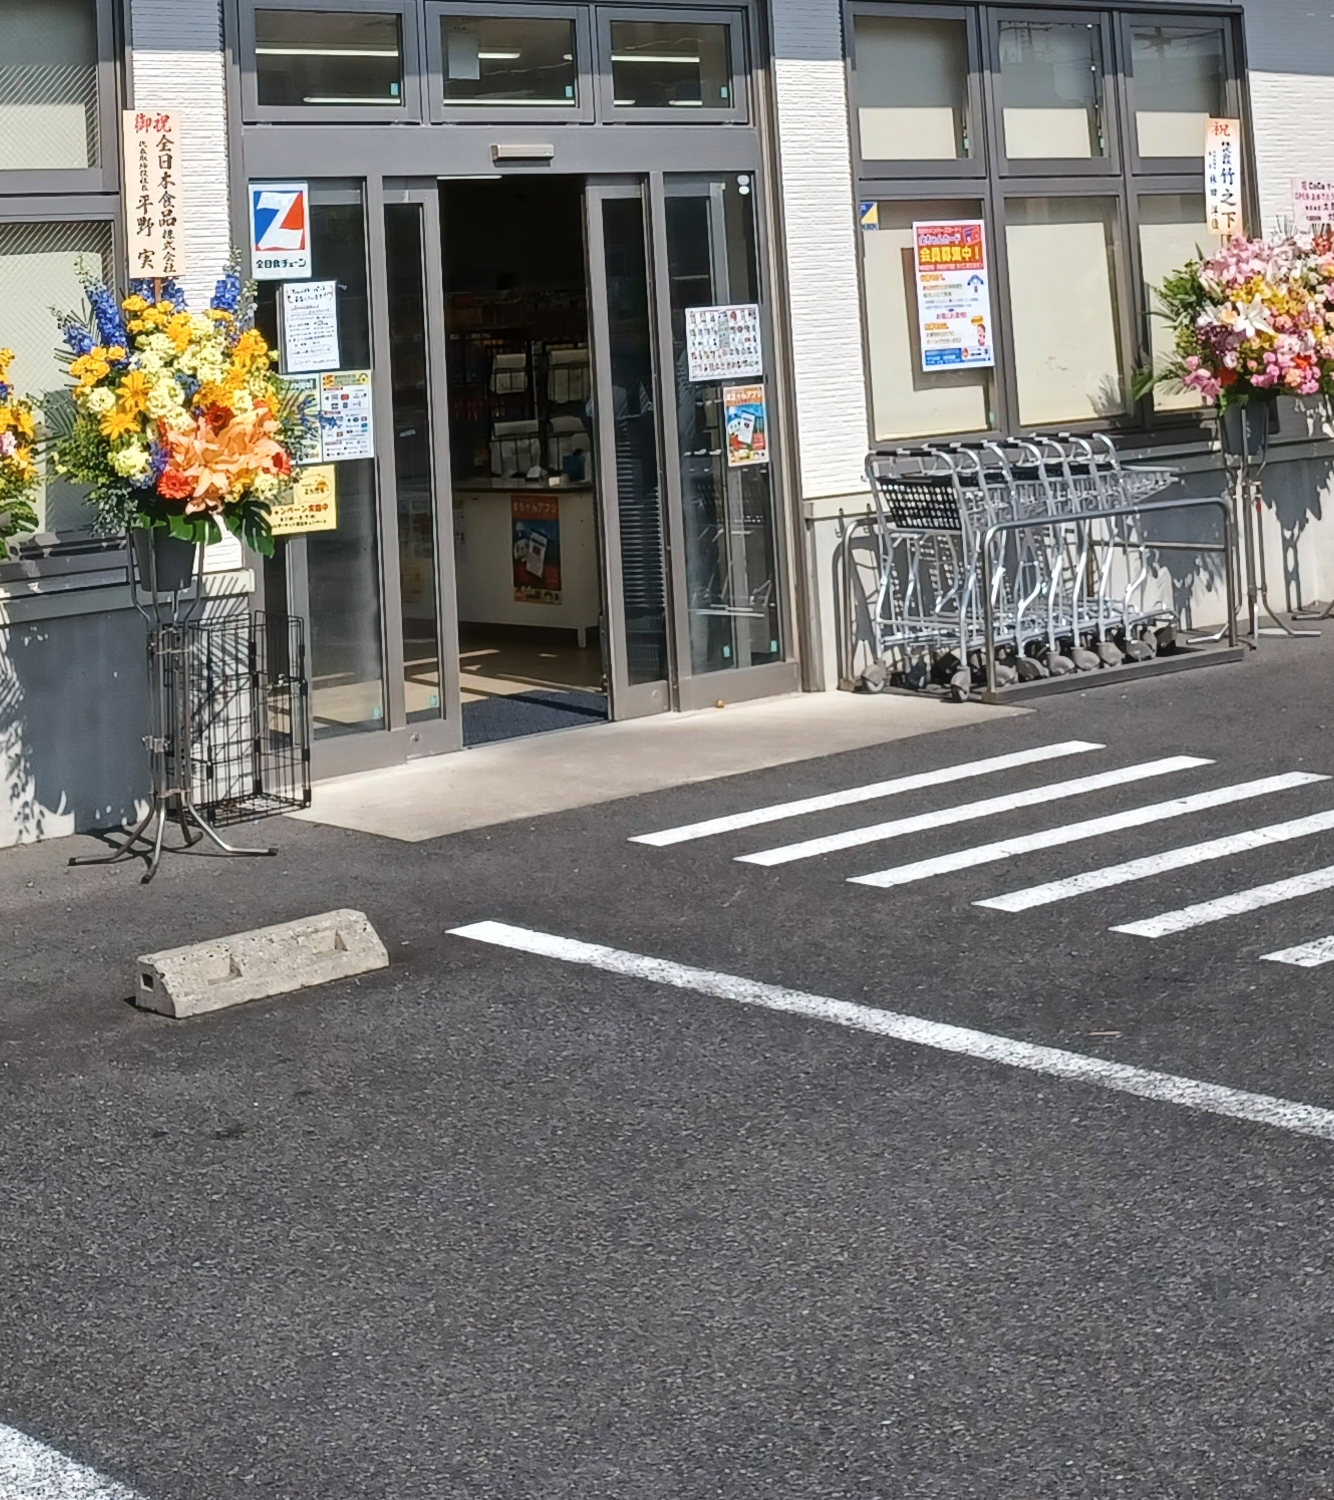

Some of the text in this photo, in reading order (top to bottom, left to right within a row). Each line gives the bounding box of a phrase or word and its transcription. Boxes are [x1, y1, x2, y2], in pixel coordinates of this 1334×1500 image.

[134, 112, 172, 134] 御祝
[1212, 121, 1231, 137] 祝
[255, 258, 307, 270] 全日食チェーン
